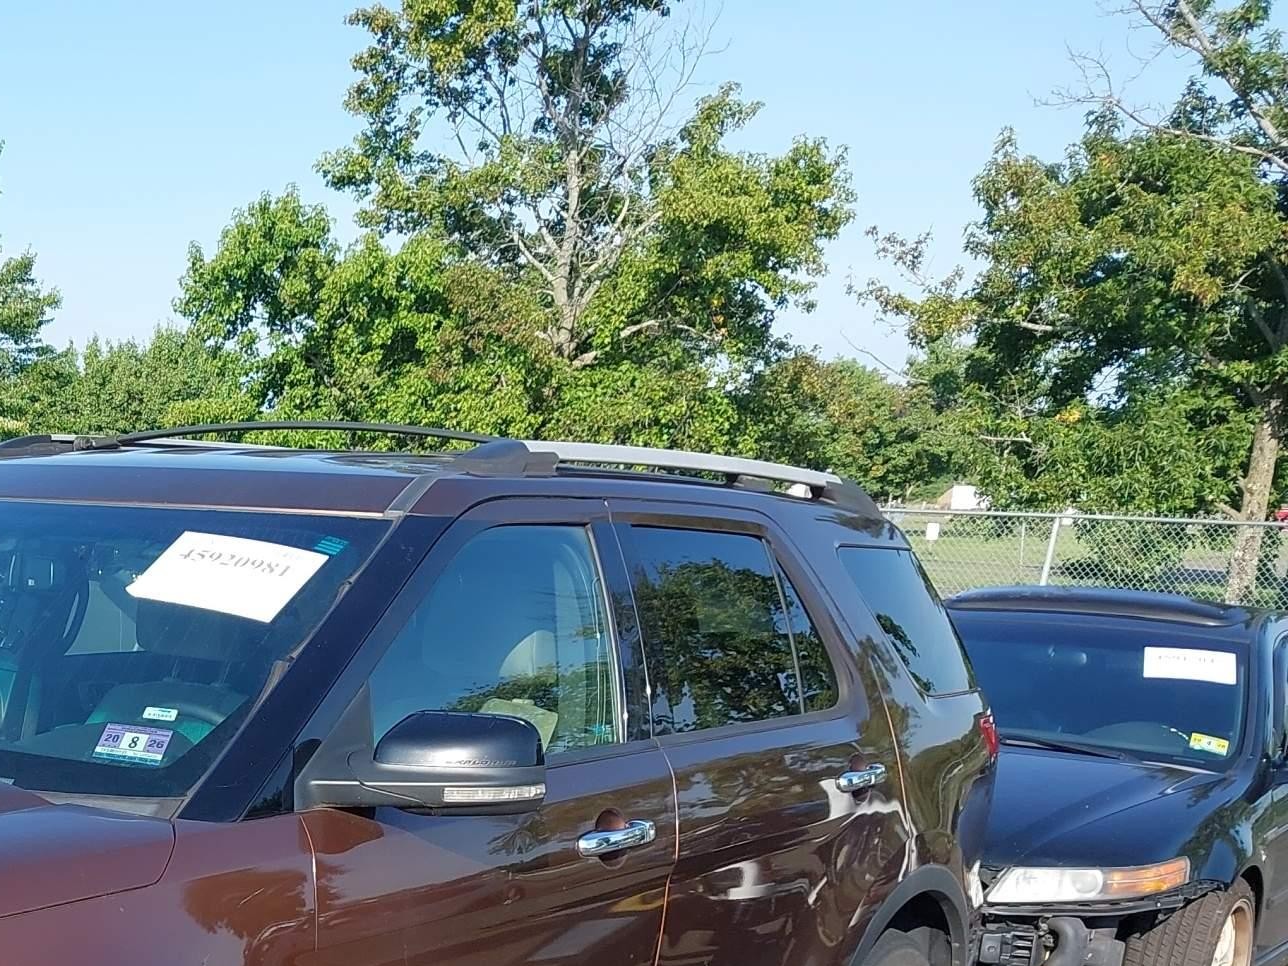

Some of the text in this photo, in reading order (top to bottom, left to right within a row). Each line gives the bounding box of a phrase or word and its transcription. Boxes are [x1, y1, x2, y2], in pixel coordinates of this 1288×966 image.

[179, 549, 291, 577] 45920981
[104, 734, 120, 743] 20
[128, 736, 139, 749] 8
[148, 740, 165, 749] 26
